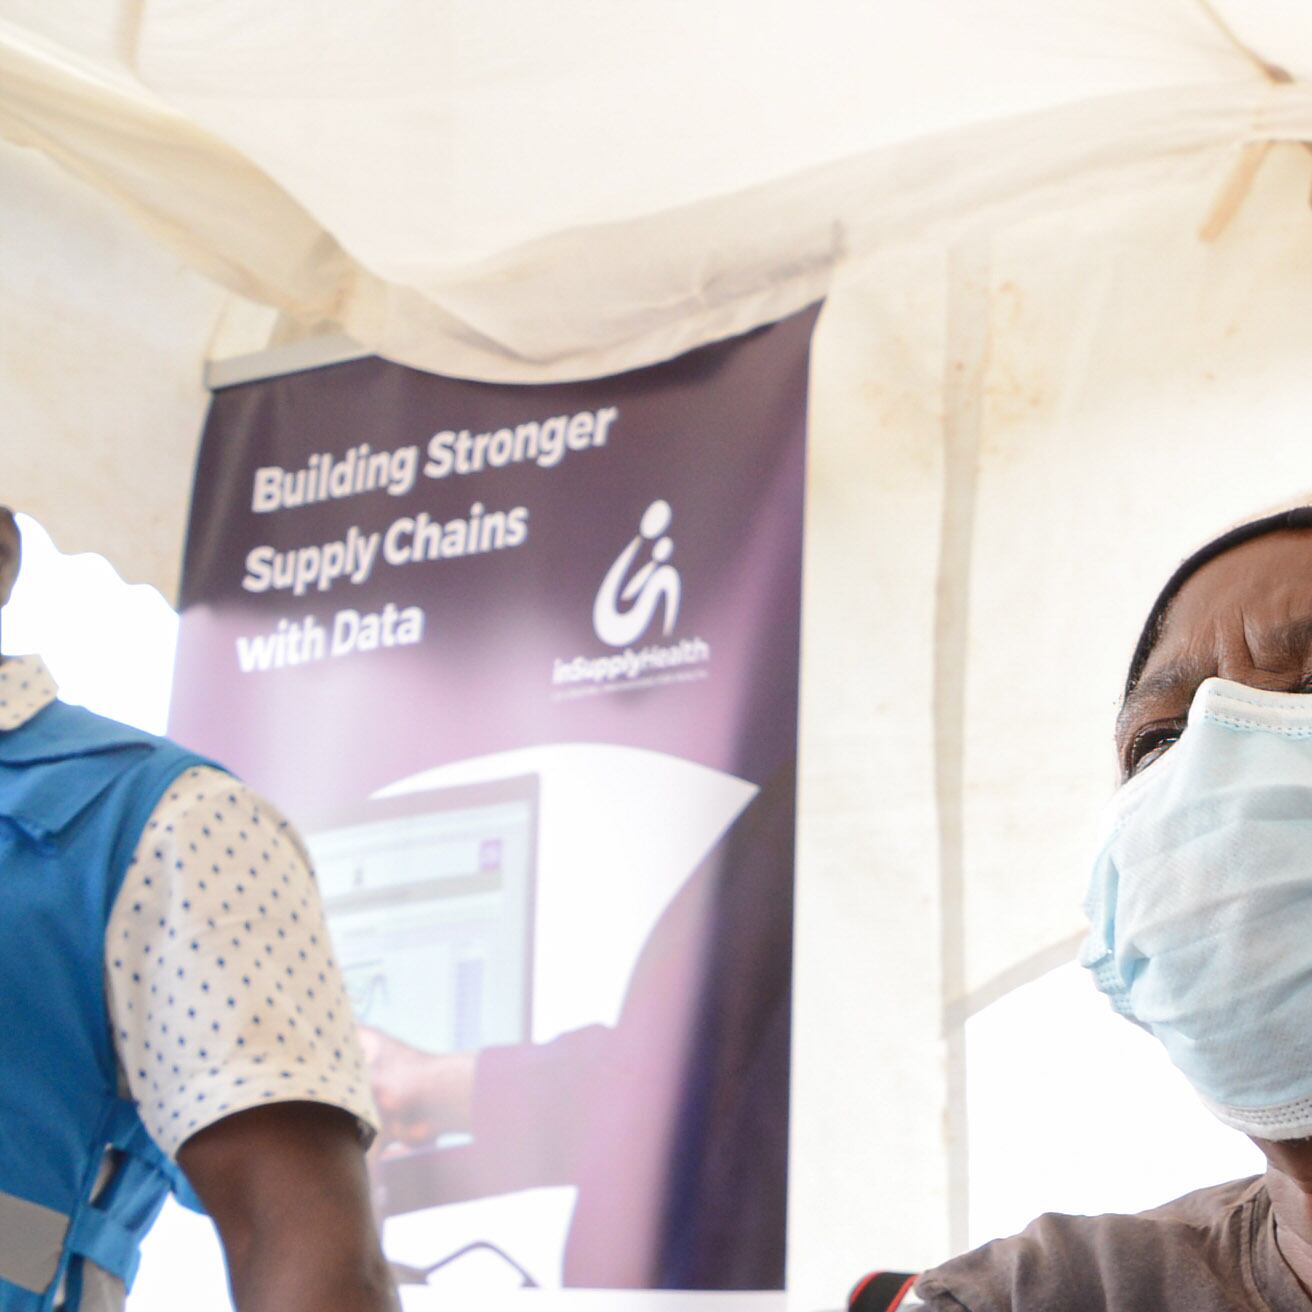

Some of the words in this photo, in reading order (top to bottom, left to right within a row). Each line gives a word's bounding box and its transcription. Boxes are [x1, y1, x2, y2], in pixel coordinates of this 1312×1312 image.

[251, 443, 416, 513] Building
[423, 405, 619, 480] Stronger
[242, 531, 381, 597] Supply
[384, 502, 529, 567] Chains
[236, 616, 325, 674] with
[330, 604, 424, 656] Data
